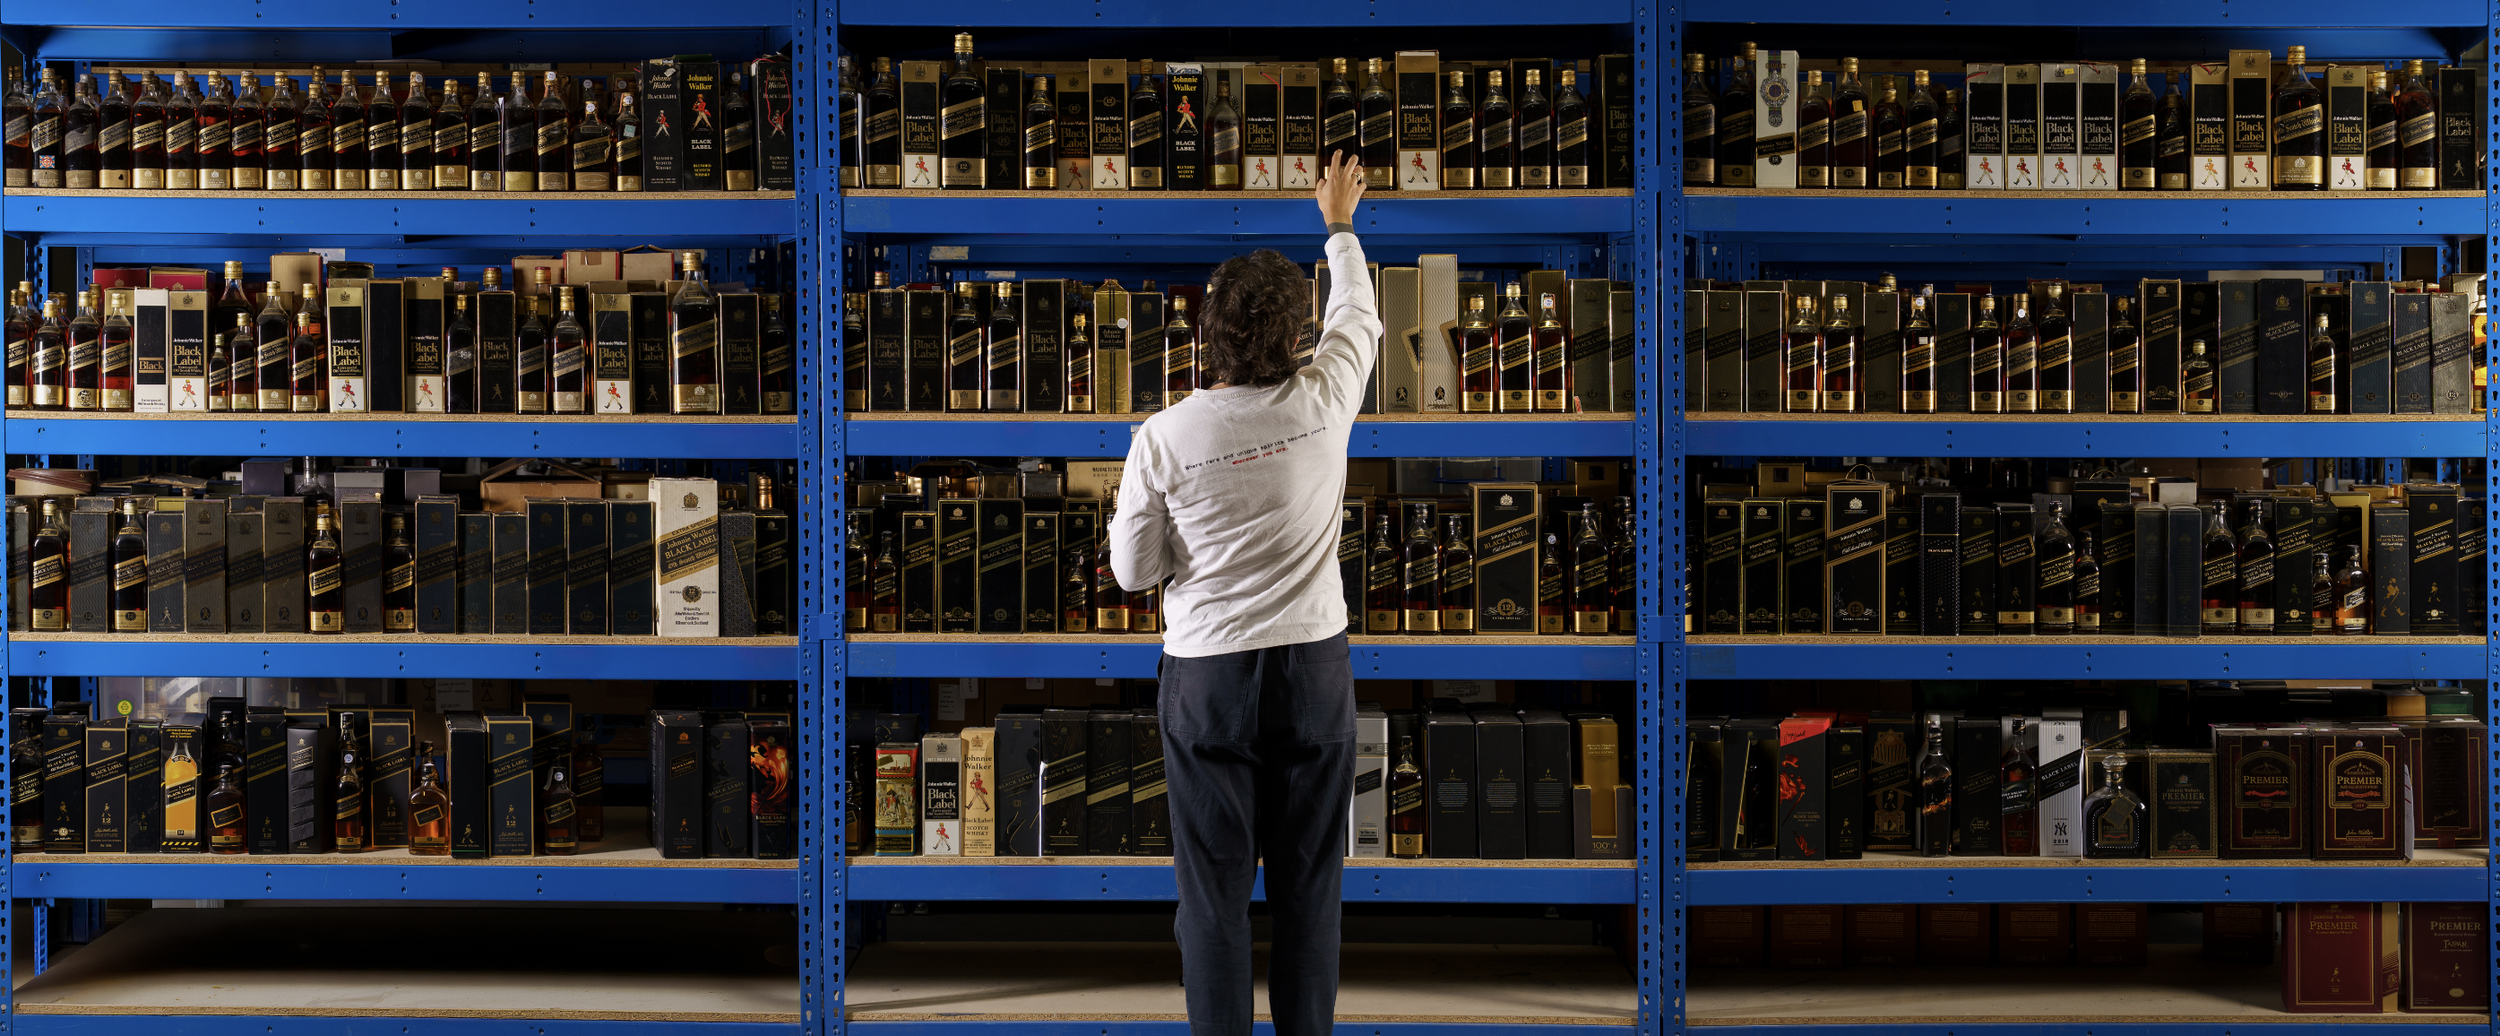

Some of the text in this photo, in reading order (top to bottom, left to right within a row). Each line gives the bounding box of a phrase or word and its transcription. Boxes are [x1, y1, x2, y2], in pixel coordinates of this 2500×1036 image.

[687, 74, 713, 82] Johnnie
[1172, 76, 1198, 84] Johnnie
[1173, 84, 1197, 92] Walker
[1404, 113, 1432, 124] Black
[2445, 117, 2471, 127] Black
[906, 121, 935, 132] Black
[1094, 123, 1123, 134] Black
[1247, 124, 1275, 134] Black
[1286, 123, 1314, 134] Black
[1404, 123, 1432, 134] Label
[1971, 122, 1999, 134] Black
[2009, 124, 2036, 135] Black
[2046, 122, 2074, 134] Black
[2084, 122, 2112, 134] Black
[2196, 124, 2224, 135] Black
[2236, 120, 2264, 132] Black
[2333, 123, 2362, 134] Black
[2445, 126, 2472, 136] Label
[906, 132, 935, 142] Label
[1060, 127, 1088, 138] Black
[2236, 131, 2265, 142] Label
[1060, 138, 1088, 148] Label
[1094, 133, 1123, 144] Label
[1247, 134, 1275, 145] Label
[1286, 133, 1314, 144] Label
[1971, 133, 2000, 144] Label
[2010, 134, 2036, 144] Label
[2046, 133, 2075, 144] Label
[2084, 133, 2113, 144] Label
[2196, 134, 2224, 145] Label
[2333, 133, 2362, 144] Label
[1030, 334, 1056, 344] Black
[173, 344, 201, 356] Black
[410, 342, 438, 352] Black
[483, 341, 509, 351] Black
[637, 342, 664, 352] Black
[727, 344, 753, 353] Black
[913, 340, 940, 350] Black
[1030, 344, 1057, 353] Label
[332, 346, 360, 356] Black
[483, 351, 510, 360] Label
[598, 348, 627, 358] Black
[638, 352, 664, 361] Label
[913, 349, 940, 359] Label
[173, 355, 202, 366] Label
[332, 355, 360, 366] Label
[410, 352, 439, 363] Label
[727, 352, 754, 362] Label
[139, 360, 164, 370] Black
[598, 358, 627, 368] Label
[666, 537, 691, 550] Johnnie
[1484, 529, 1530, 550] BLACK LABEL
[1833, 530, 1879, 550] BLACK LABEL
[664, 535, 718, 560] BLACK LABEL
[964, 754, 992, 762] Johnnie
[493, 758, 529, 774] BLACK LABEL
[2041, 762, 2078, 781] BLACK LABEL
[2243, 775, 2289, 784] PREMIER
[2336, 776, 2383, 785] PREMIER
[928, 788, 956, 800] Black
[2162, 792, 2205, 800] PREMIER
[928, 799, 956, 810] Label
[2309, 921, 2358, 930] PREMIER
[2430, 921, 2481, 931] PREMIER
